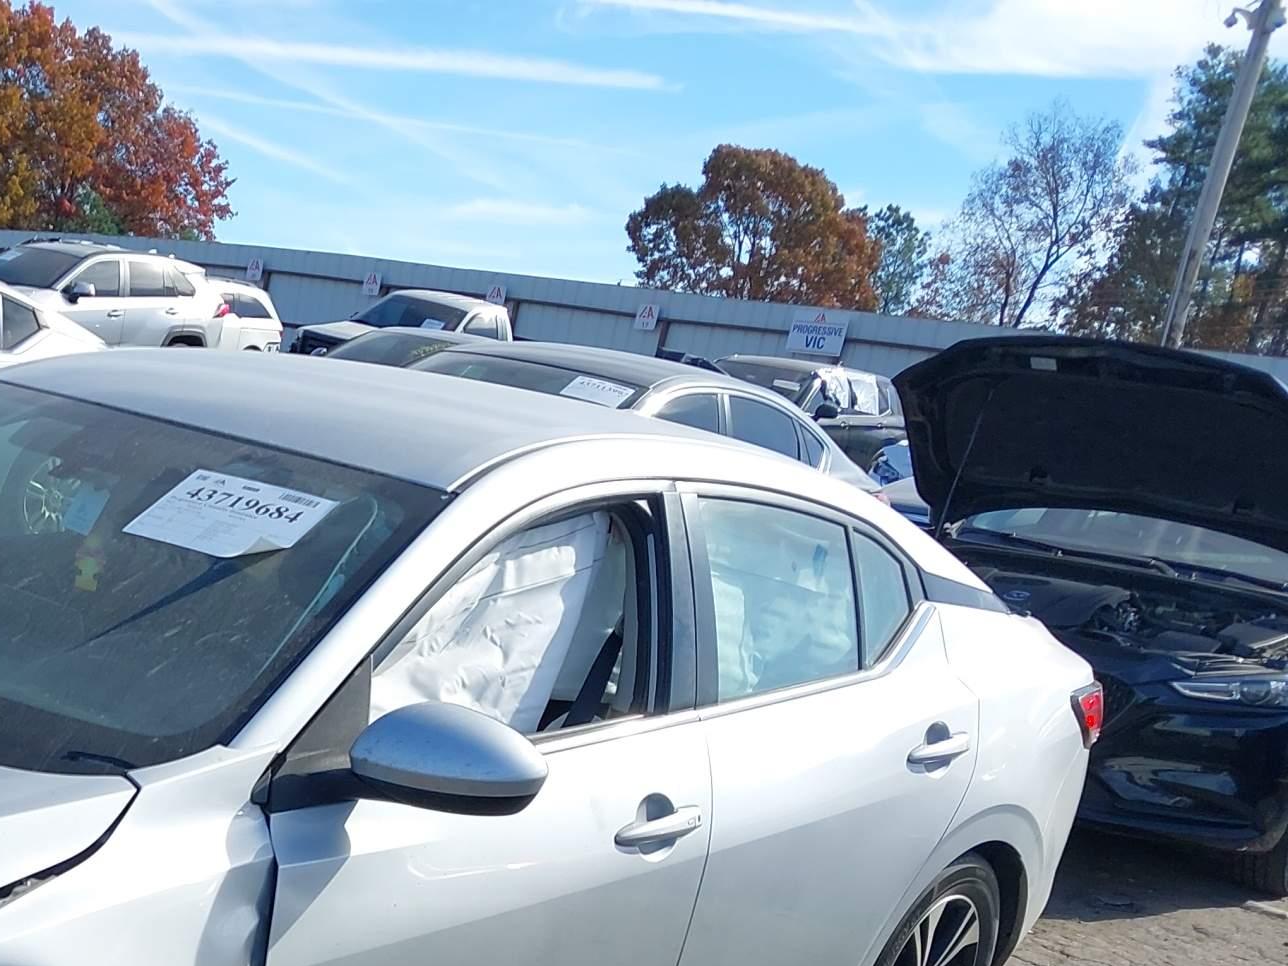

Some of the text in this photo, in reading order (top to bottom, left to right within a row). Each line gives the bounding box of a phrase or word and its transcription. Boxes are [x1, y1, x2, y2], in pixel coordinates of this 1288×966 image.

[792, 323, 844, 337] PROGRESSIVE
[805, 335, 826, 350] VIC
[186, 486, 304, 523] 43719684
